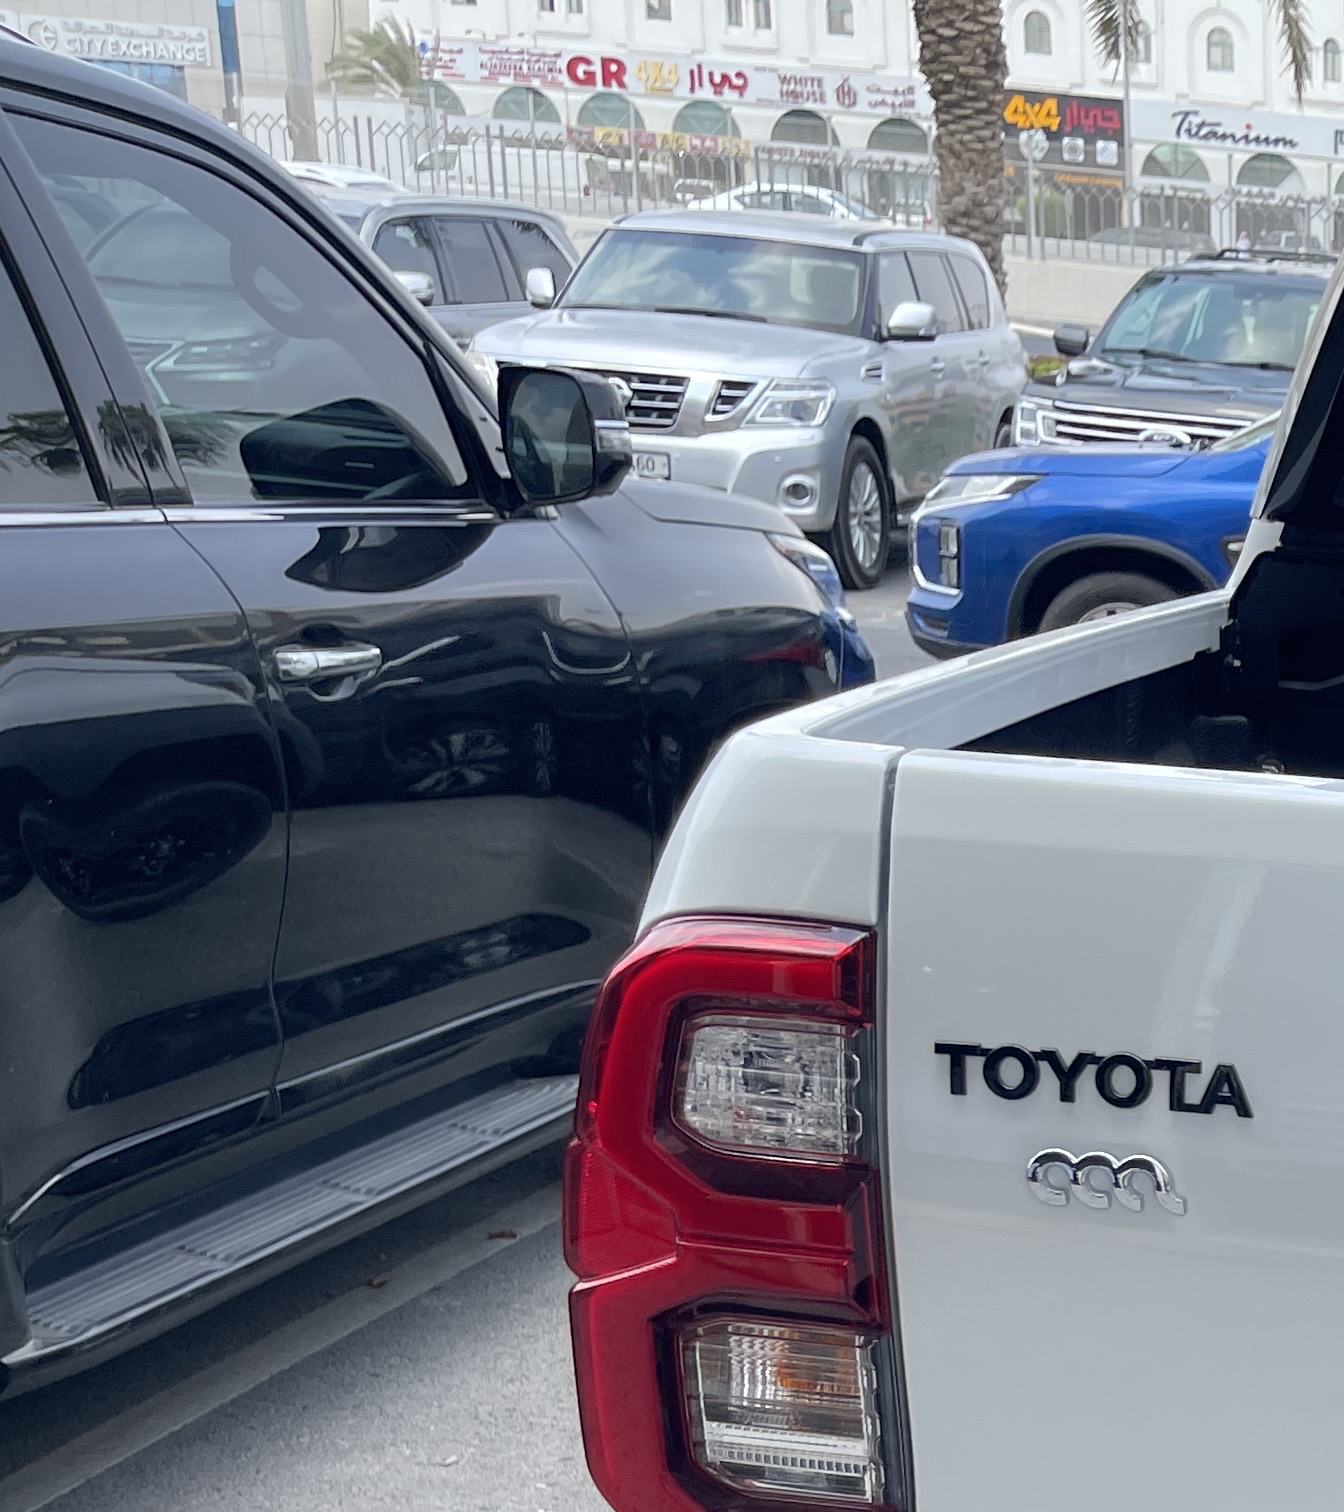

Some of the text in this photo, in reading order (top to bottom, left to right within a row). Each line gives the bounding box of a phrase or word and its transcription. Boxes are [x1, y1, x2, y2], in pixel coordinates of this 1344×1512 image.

[566, 55, 627, 90] GR
[777, 73, 825, 89] WHITE
[779, 89, 827, 105] HOUSE
[1171, 109, 1299, 150] Titanium
[934, 1040, 1255, 1118] TOYOTA
